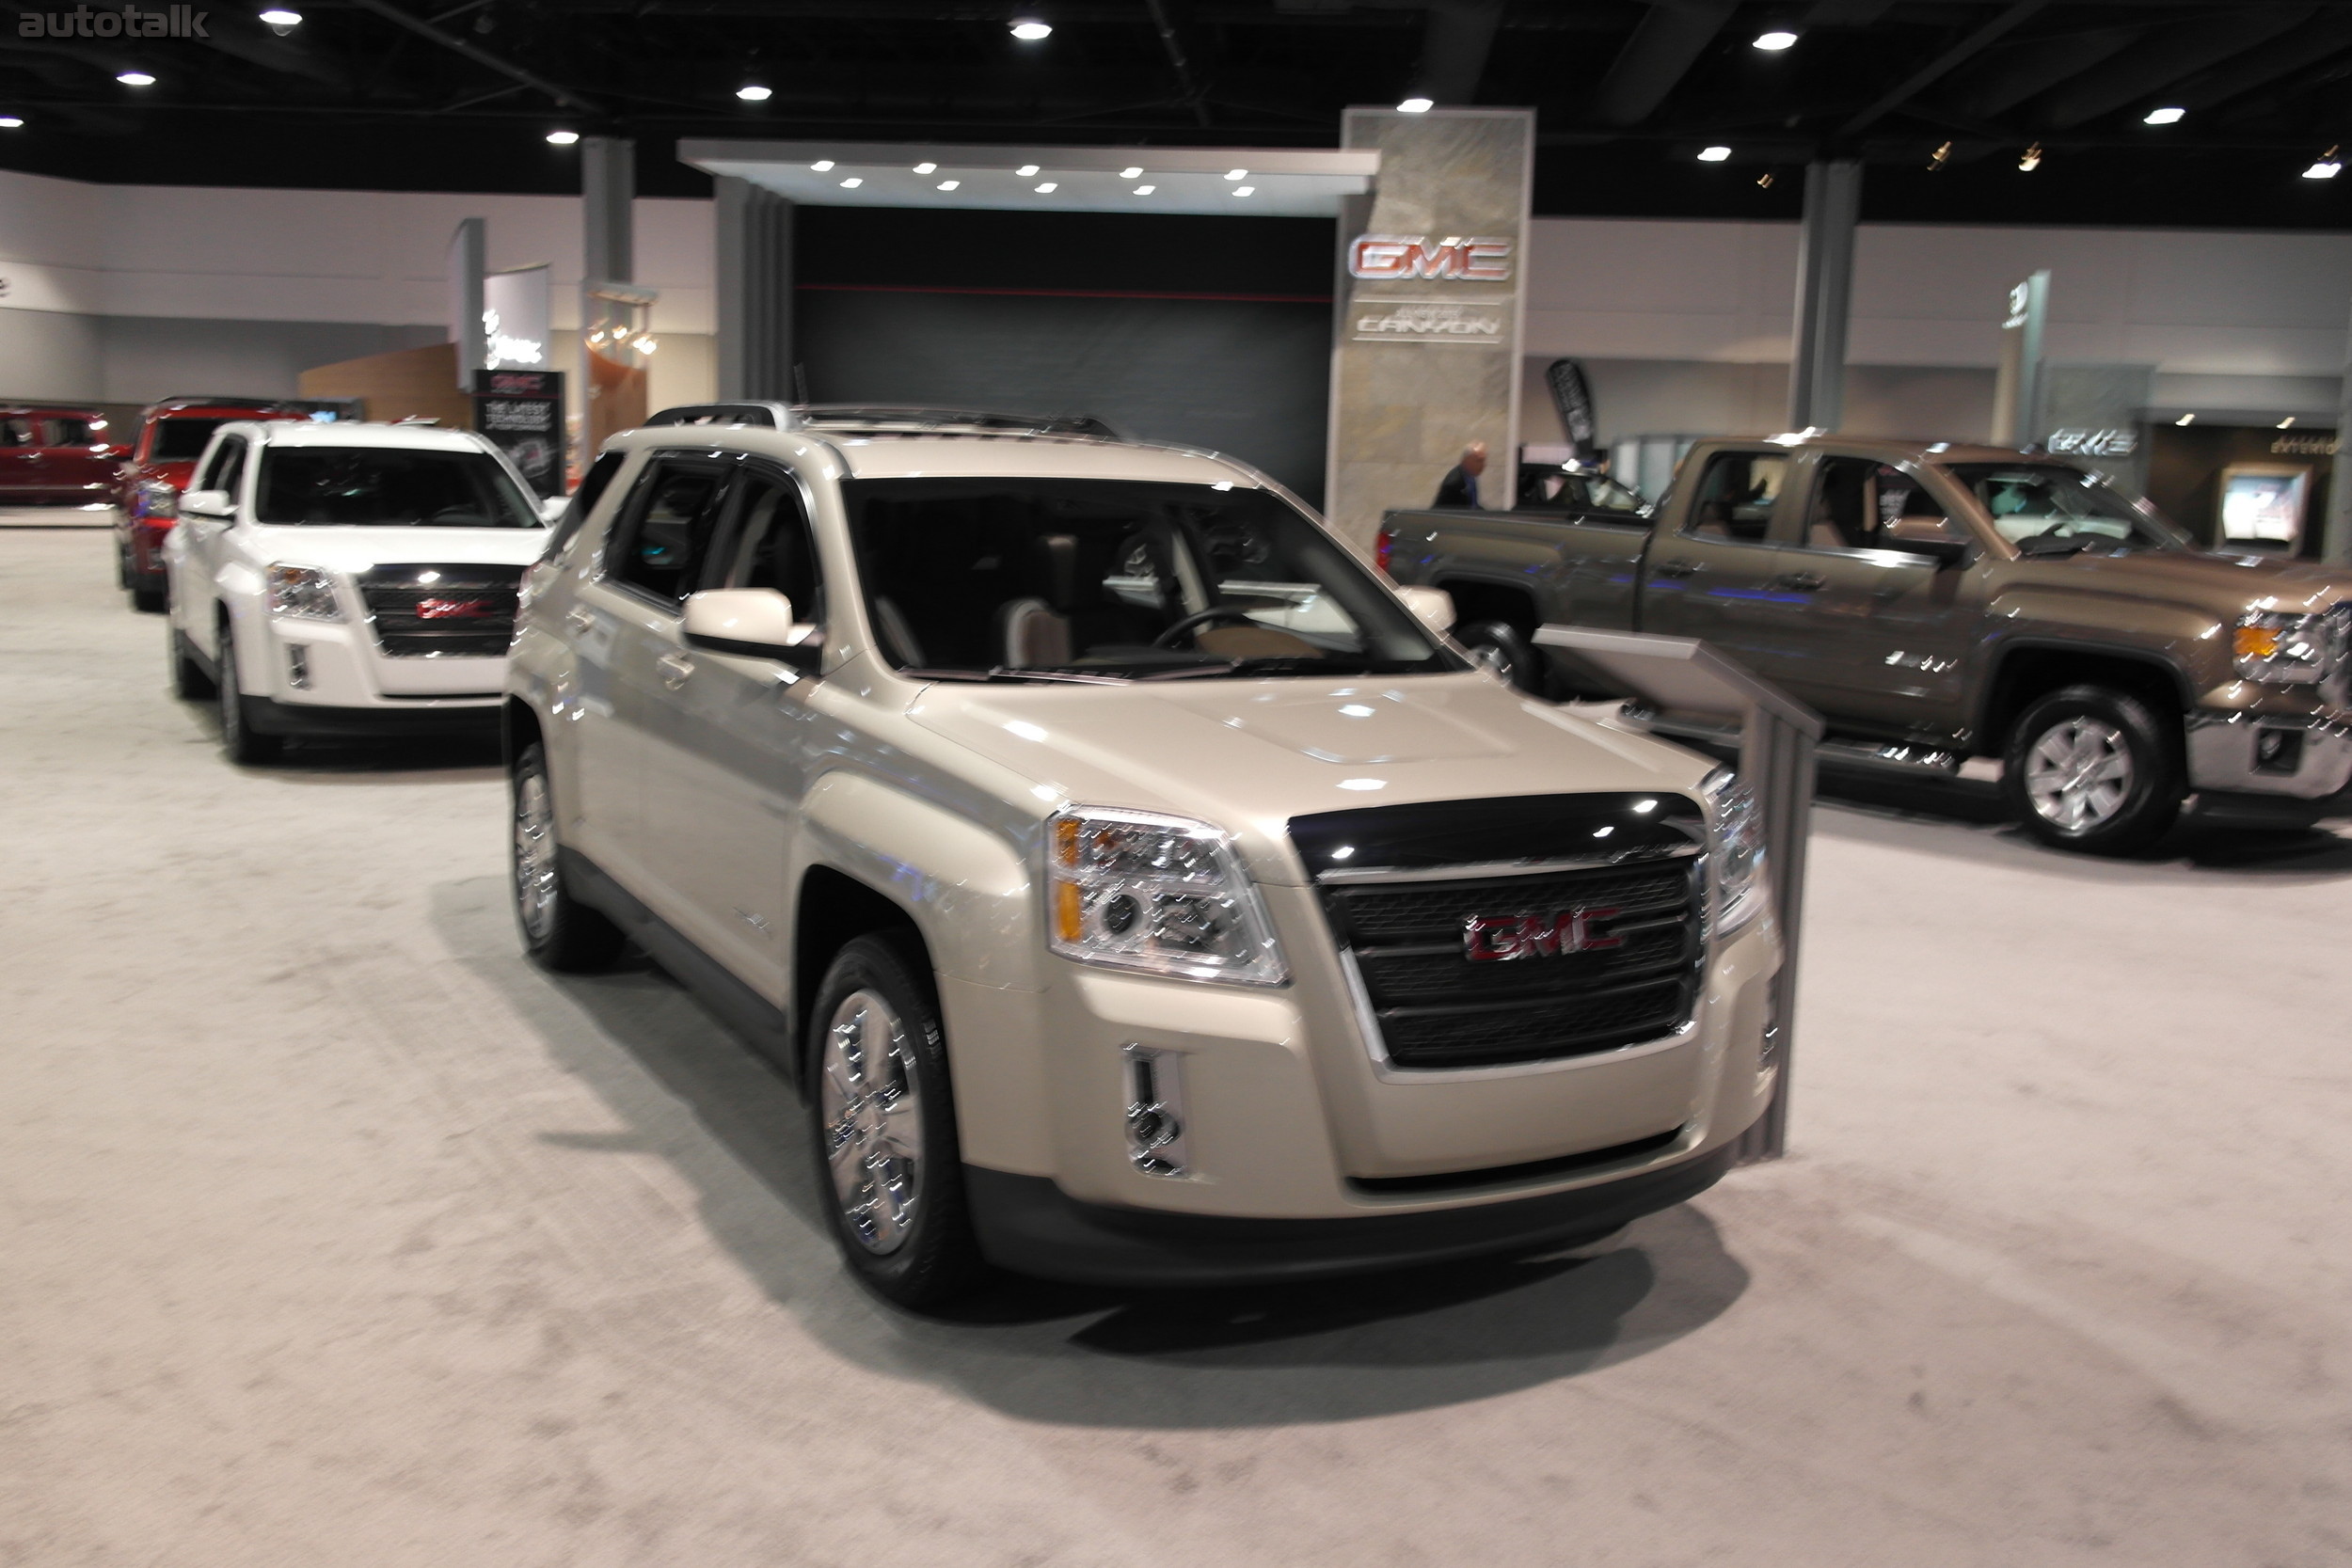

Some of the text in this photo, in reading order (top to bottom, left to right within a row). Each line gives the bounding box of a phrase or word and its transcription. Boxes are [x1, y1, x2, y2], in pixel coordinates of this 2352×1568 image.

[1348, 234, 1512, 280] GMC
[1357, 314, 1501, 334] CANYON
[2270, 441, 2338, 455] EXTERIO
[1463, 906, 1626, 961] GMC
